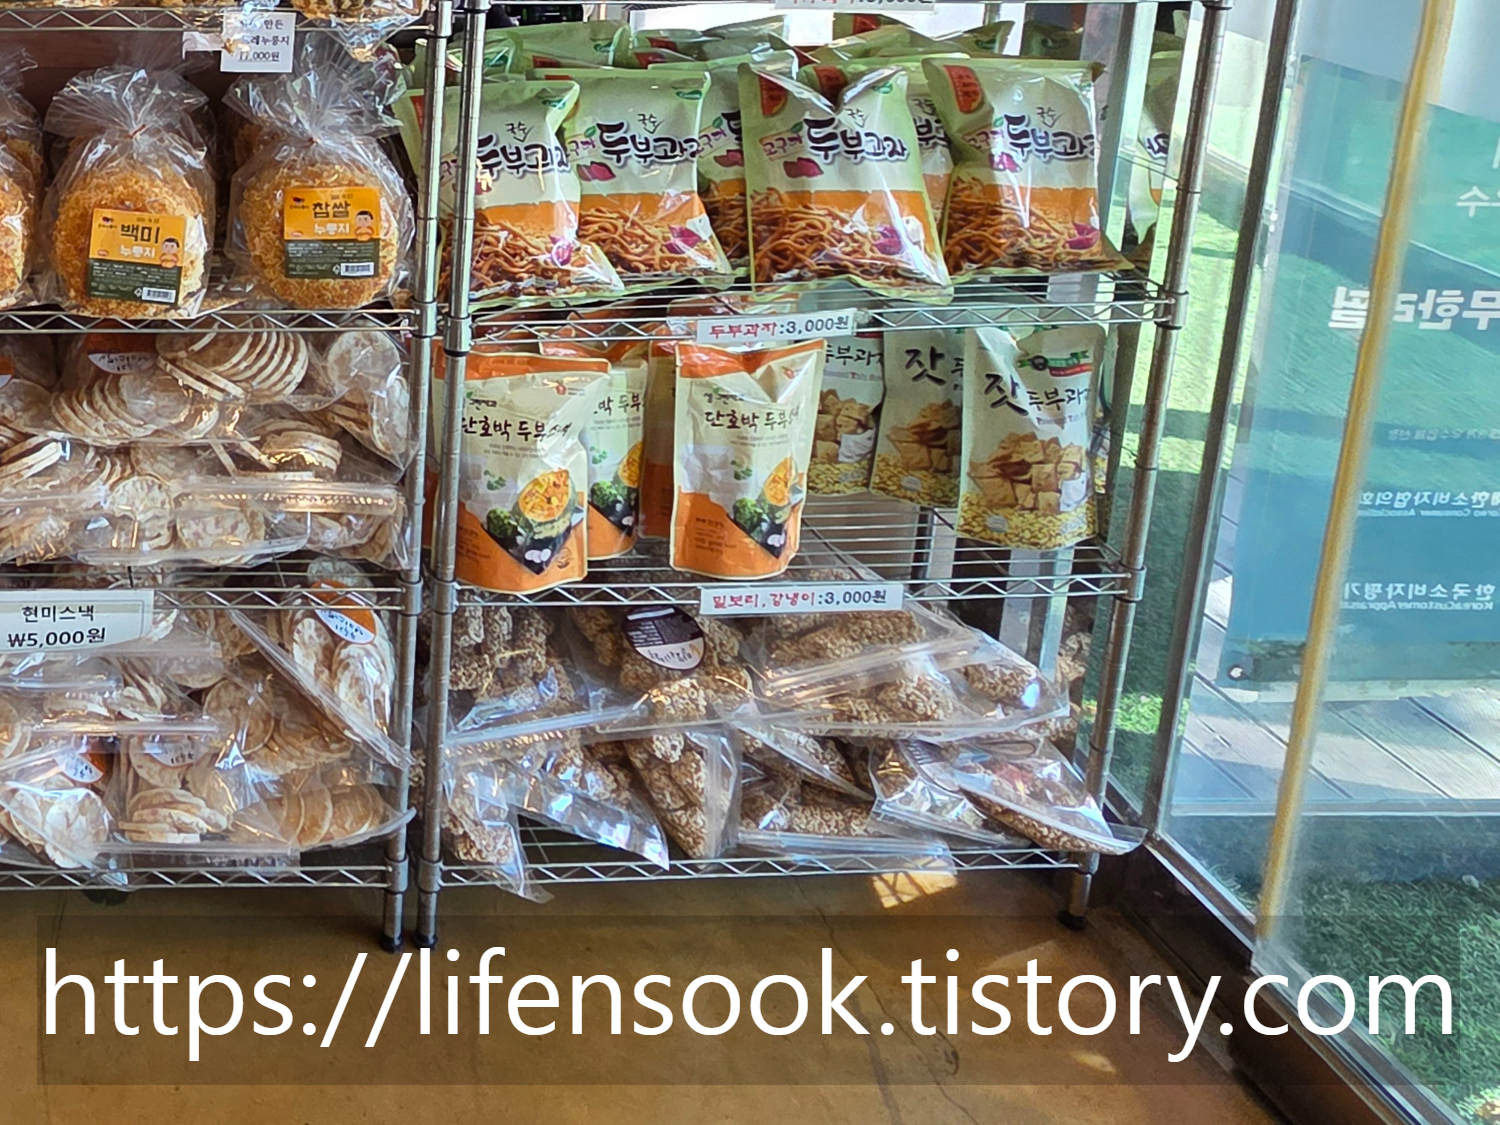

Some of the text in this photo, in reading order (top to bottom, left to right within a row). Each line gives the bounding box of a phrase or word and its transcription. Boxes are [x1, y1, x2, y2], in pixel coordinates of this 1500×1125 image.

[804, 116, 908, 162] 두부과자
[311, 200, 351, 220] 찹쌀
[120, 222, 160, 245] 백미
[313, 221, 351, 236] 누룽지
[119, 243, 157, 259] 누룽지
[905, 347, 946, 386] 잣
[984, 372, 1030, 417] 잣
[704, 409, 760, 434] 단호박
[21, 604, 95, 623] 현미스낵
[7, 627, 106, 650] ₩5,000원
